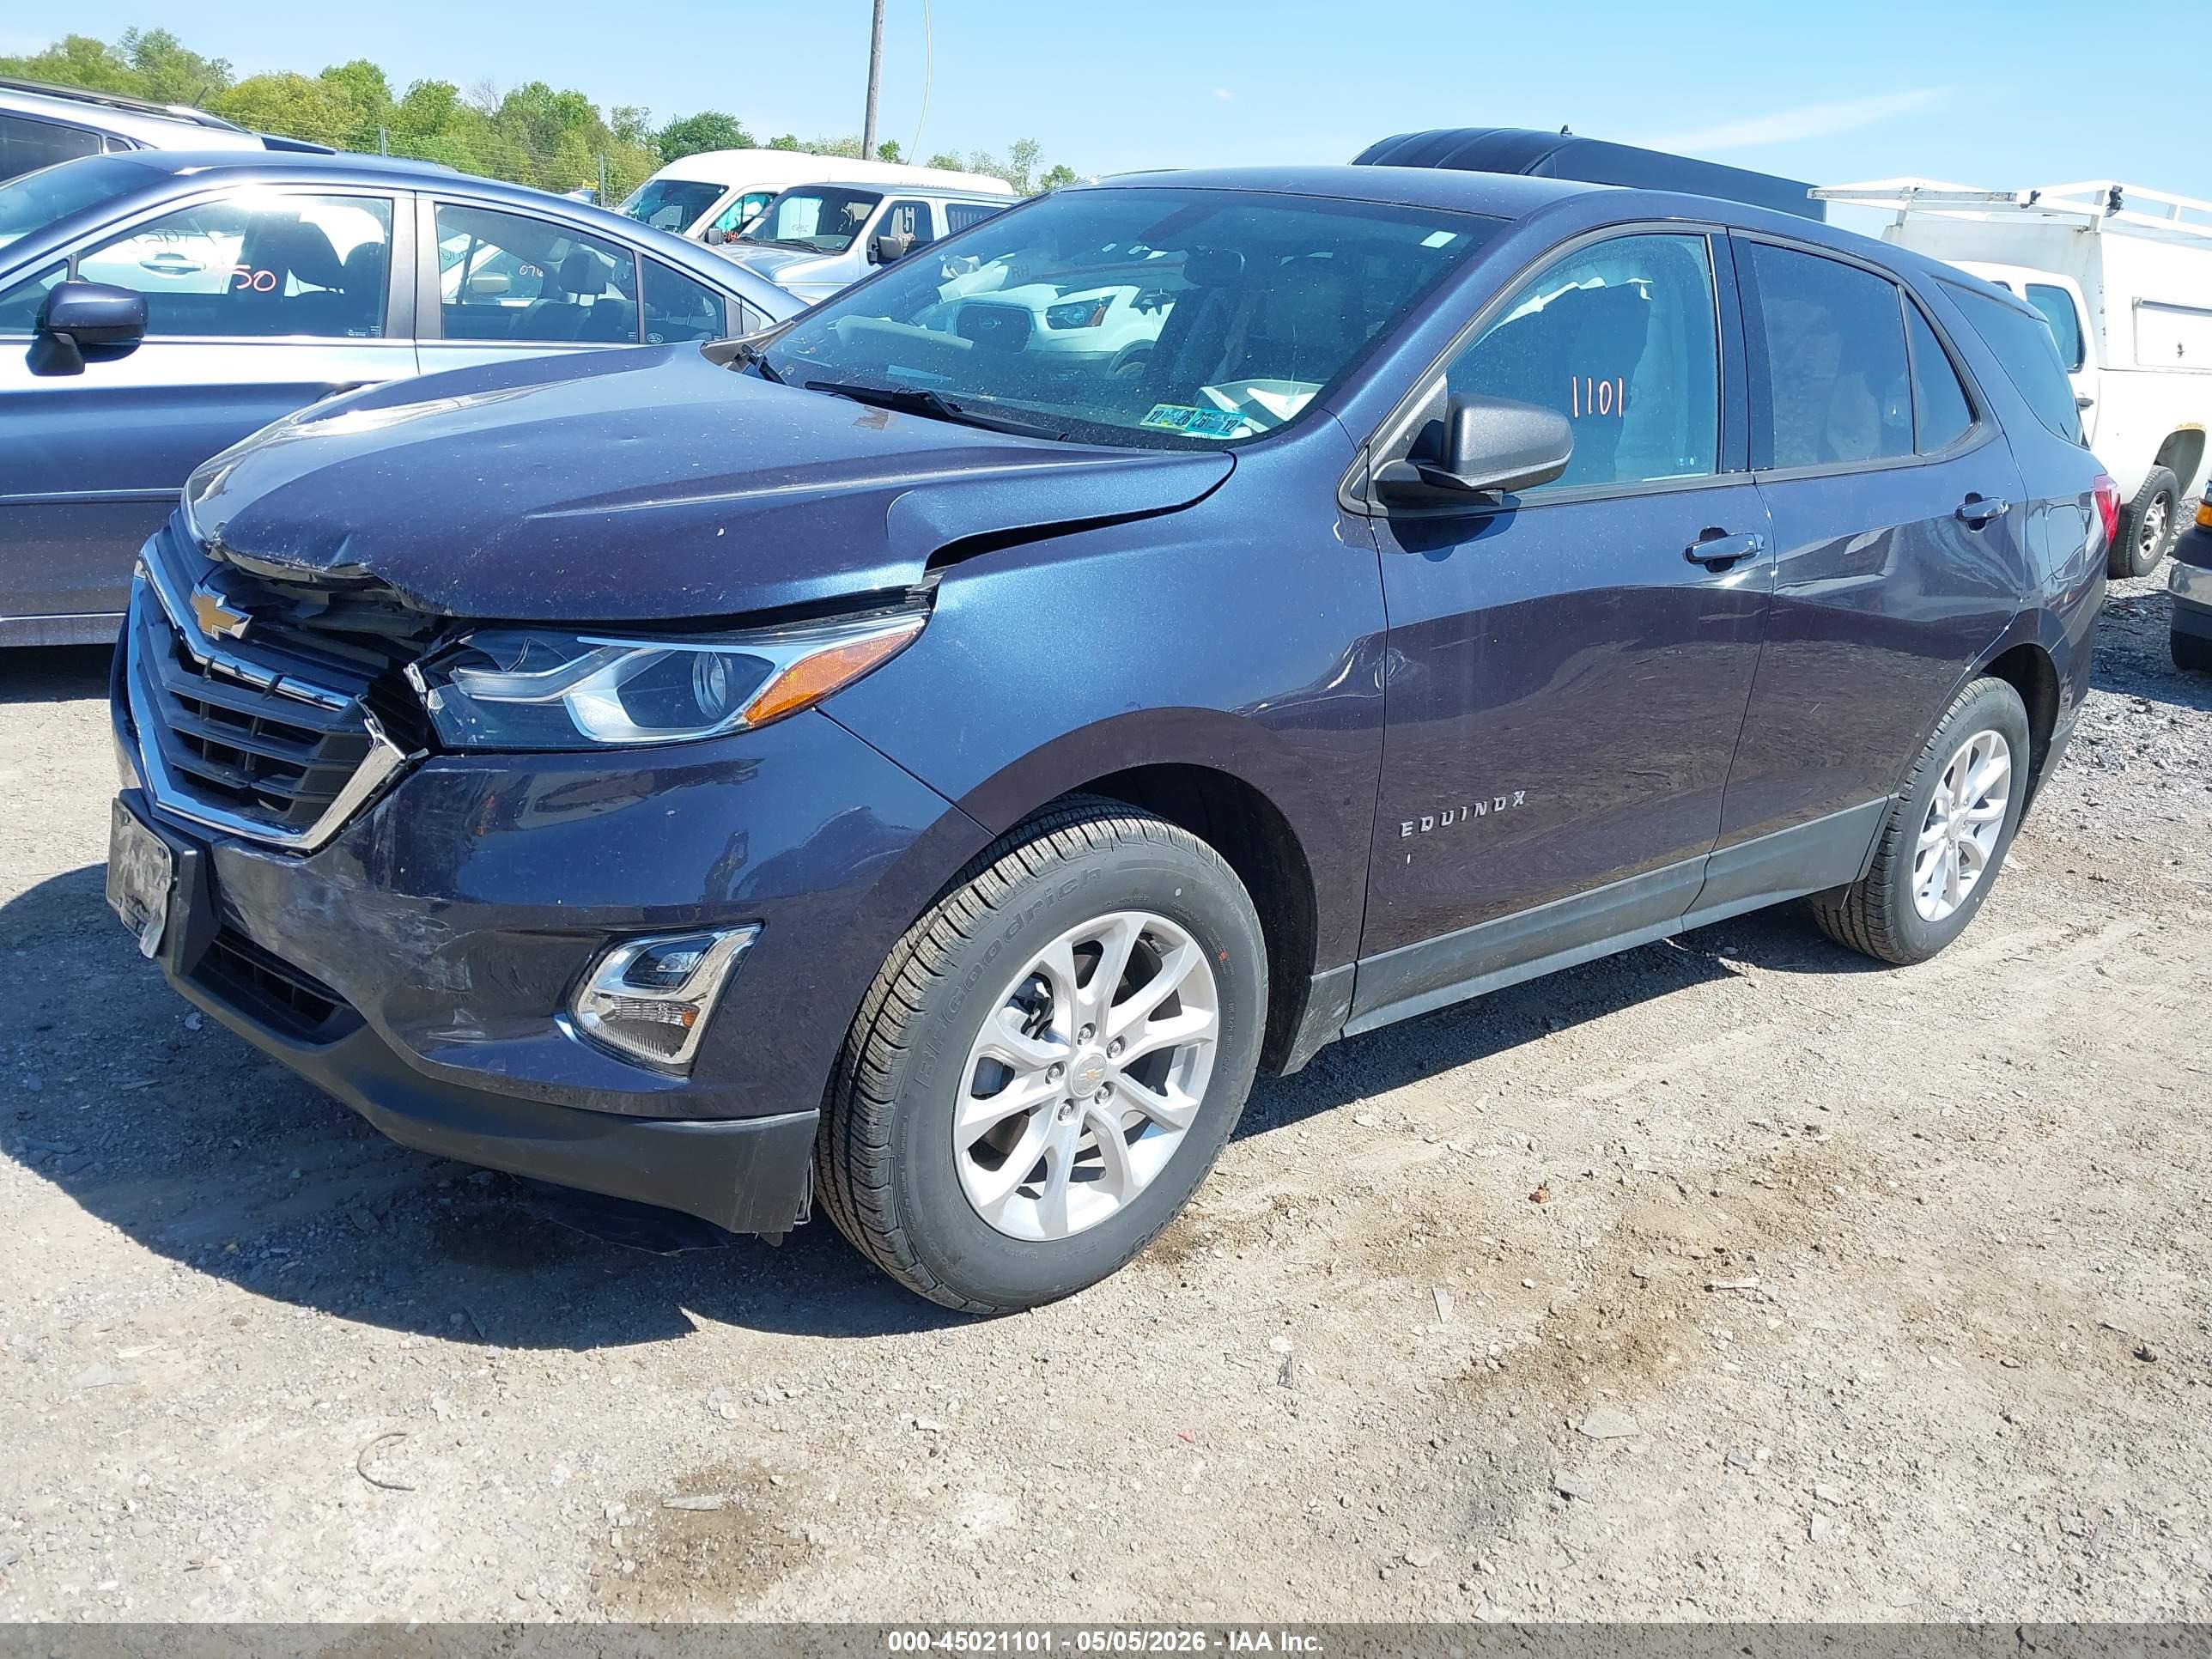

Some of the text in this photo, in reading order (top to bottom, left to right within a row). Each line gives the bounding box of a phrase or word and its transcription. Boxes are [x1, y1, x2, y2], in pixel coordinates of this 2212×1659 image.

[1572, 375, 1623, 419] 1101
[1221, 419, 1239, 433] 12
[1400, 790, 1526, 838] EQUINOX
